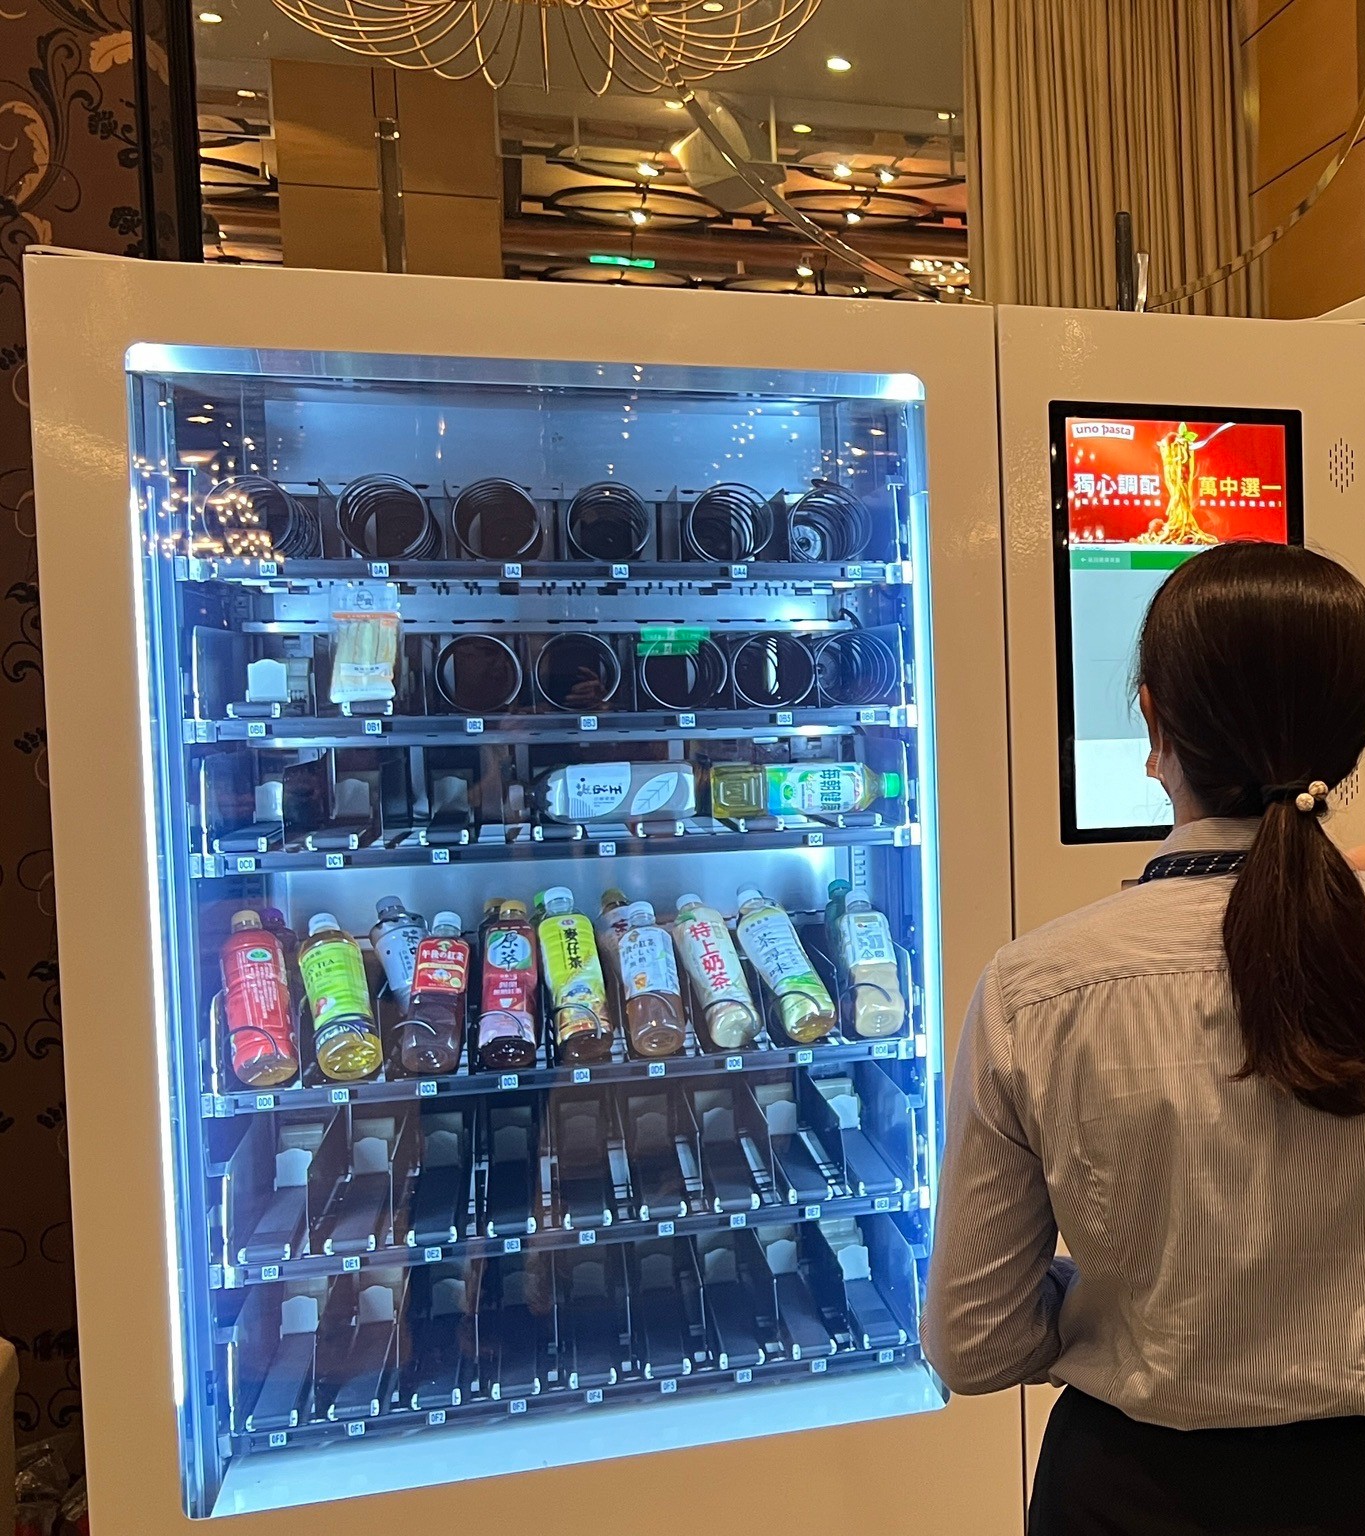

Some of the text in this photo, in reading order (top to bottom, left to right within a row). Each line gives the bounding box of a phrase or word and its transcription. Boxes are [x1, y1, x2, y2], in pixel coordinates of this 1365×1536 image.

[1075, 424, 1132, 436] uno pasta
[1073, 473, 1161, 496] 獨心調配
[1199, 476, 1281, 498] 萬中選一
[819, 768, 841, 812] 每朝健康
[689, 921, 732, 992] 特上奶茶
